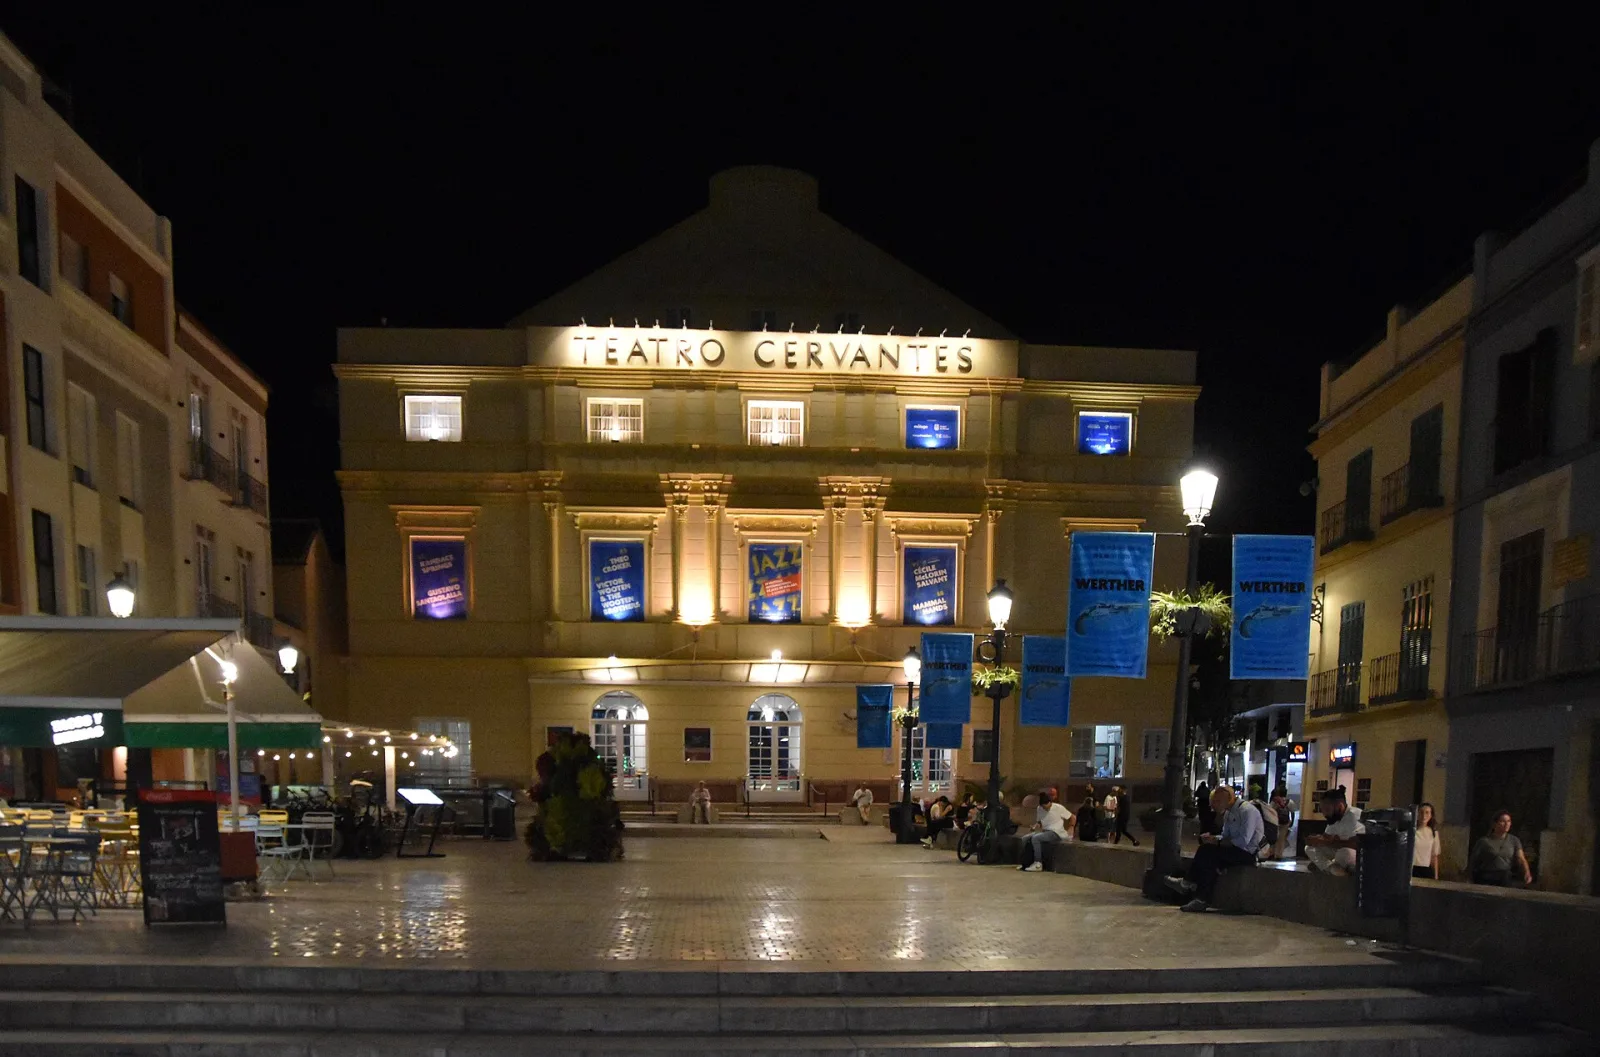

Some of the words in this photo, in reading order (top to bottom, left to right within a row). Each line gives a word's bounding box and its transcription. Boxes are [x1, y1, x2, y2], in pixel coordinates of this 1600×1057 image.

[573, 336, 725, 367] TEATRO
[753, 339, 974, 374] CERVANTES
[609, 555, 630, 565] THEO
[602, 561, 632, 574] CROKER
[915, 568, 948, 582] McLORIN
[916, 575, 948, 588] SALVANT
[428, 584, 460, 596] GUSTAVO
[596, 578, 624, 590] VICTOR
[598, 583, 632, 596] WOOTEN
[1076, 578, 1145, 592] WERTHER
[1239, 580, 1306, 593] WERTHER
[601, 596, 634, 608] WOOTEN
[607, 592, 622, 600] THE
[912, 597, 947, 611] MAMMAL
[922, 603, 948, 615] HANDS
